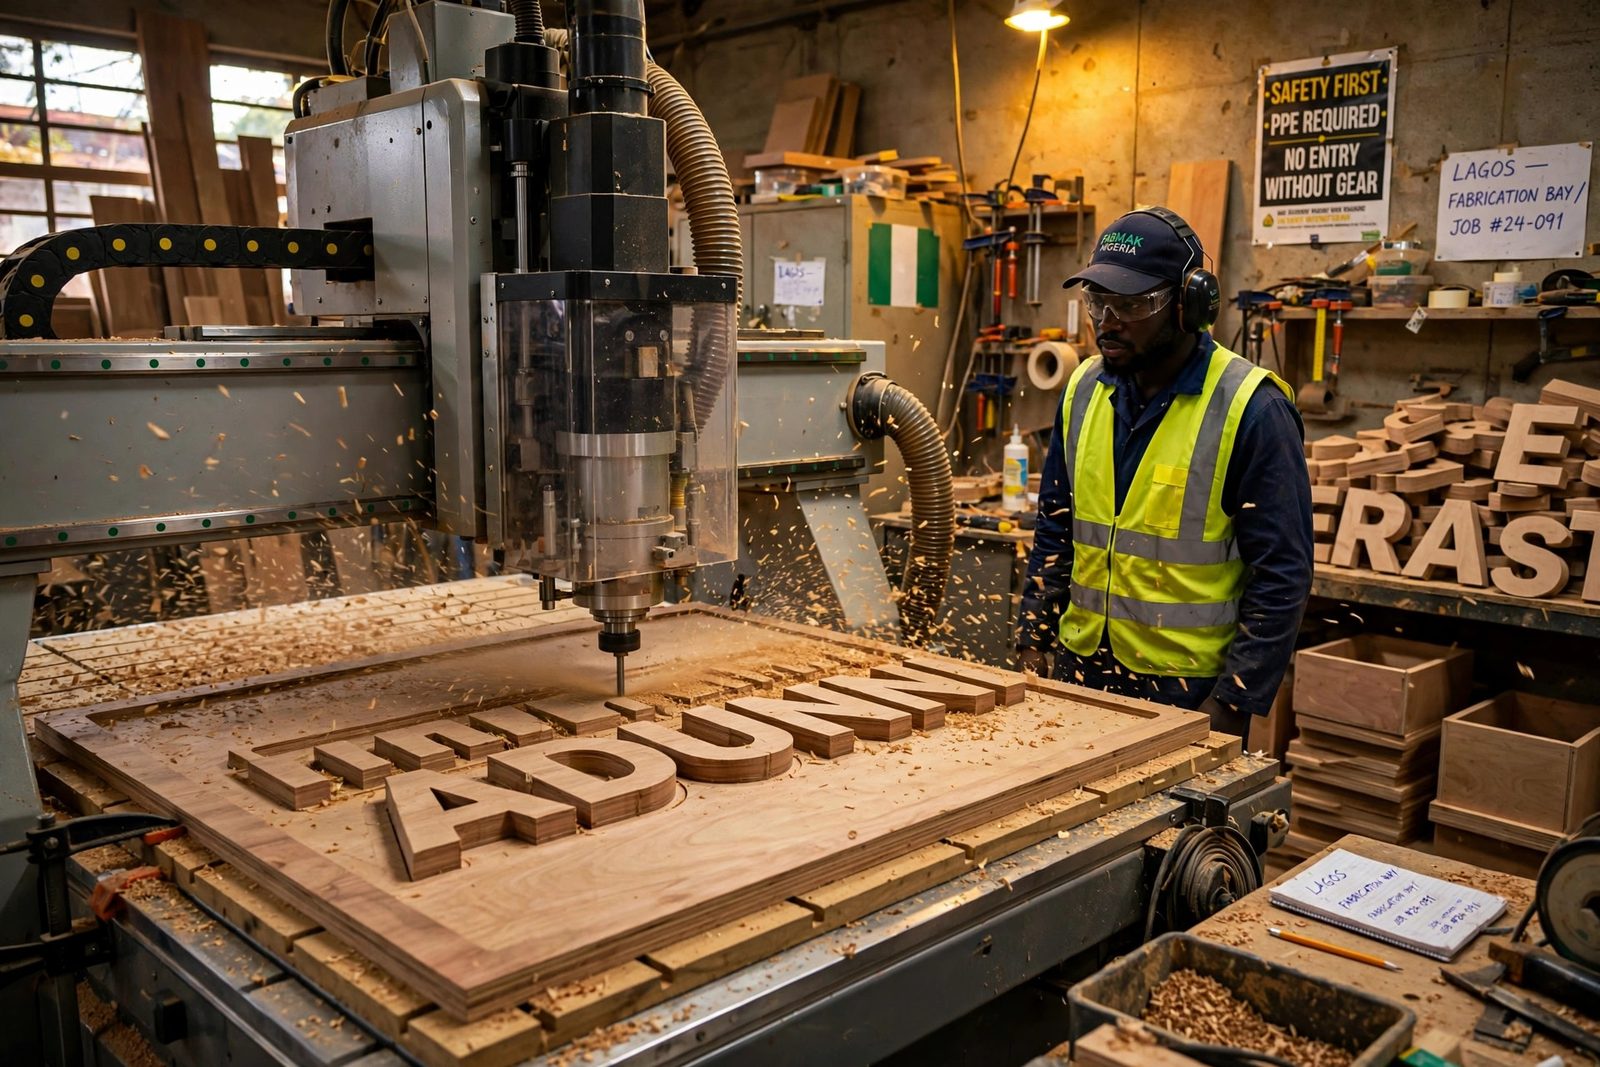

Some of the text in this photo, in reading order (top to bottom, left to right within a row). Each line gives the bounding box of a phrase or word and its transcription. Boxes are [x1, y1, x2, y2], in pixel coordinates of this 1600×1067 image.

[1271, 70, 1381, 105] SAFETY FIRST
[1270, 103, 1380, 136] PPE REQUIRED
[1284, 142, 1361, 171] NO ENTRY
[1452, 159, 1516, 182] LAGOS
[1265, 170, 1378, 200] WITHOUT GEAR
[1448, 187, 1539, 209] FABRICATION
[1450, 212, 1564, 236] JOB #24-091
[1305, 869, 1347, 895] LAGOS
